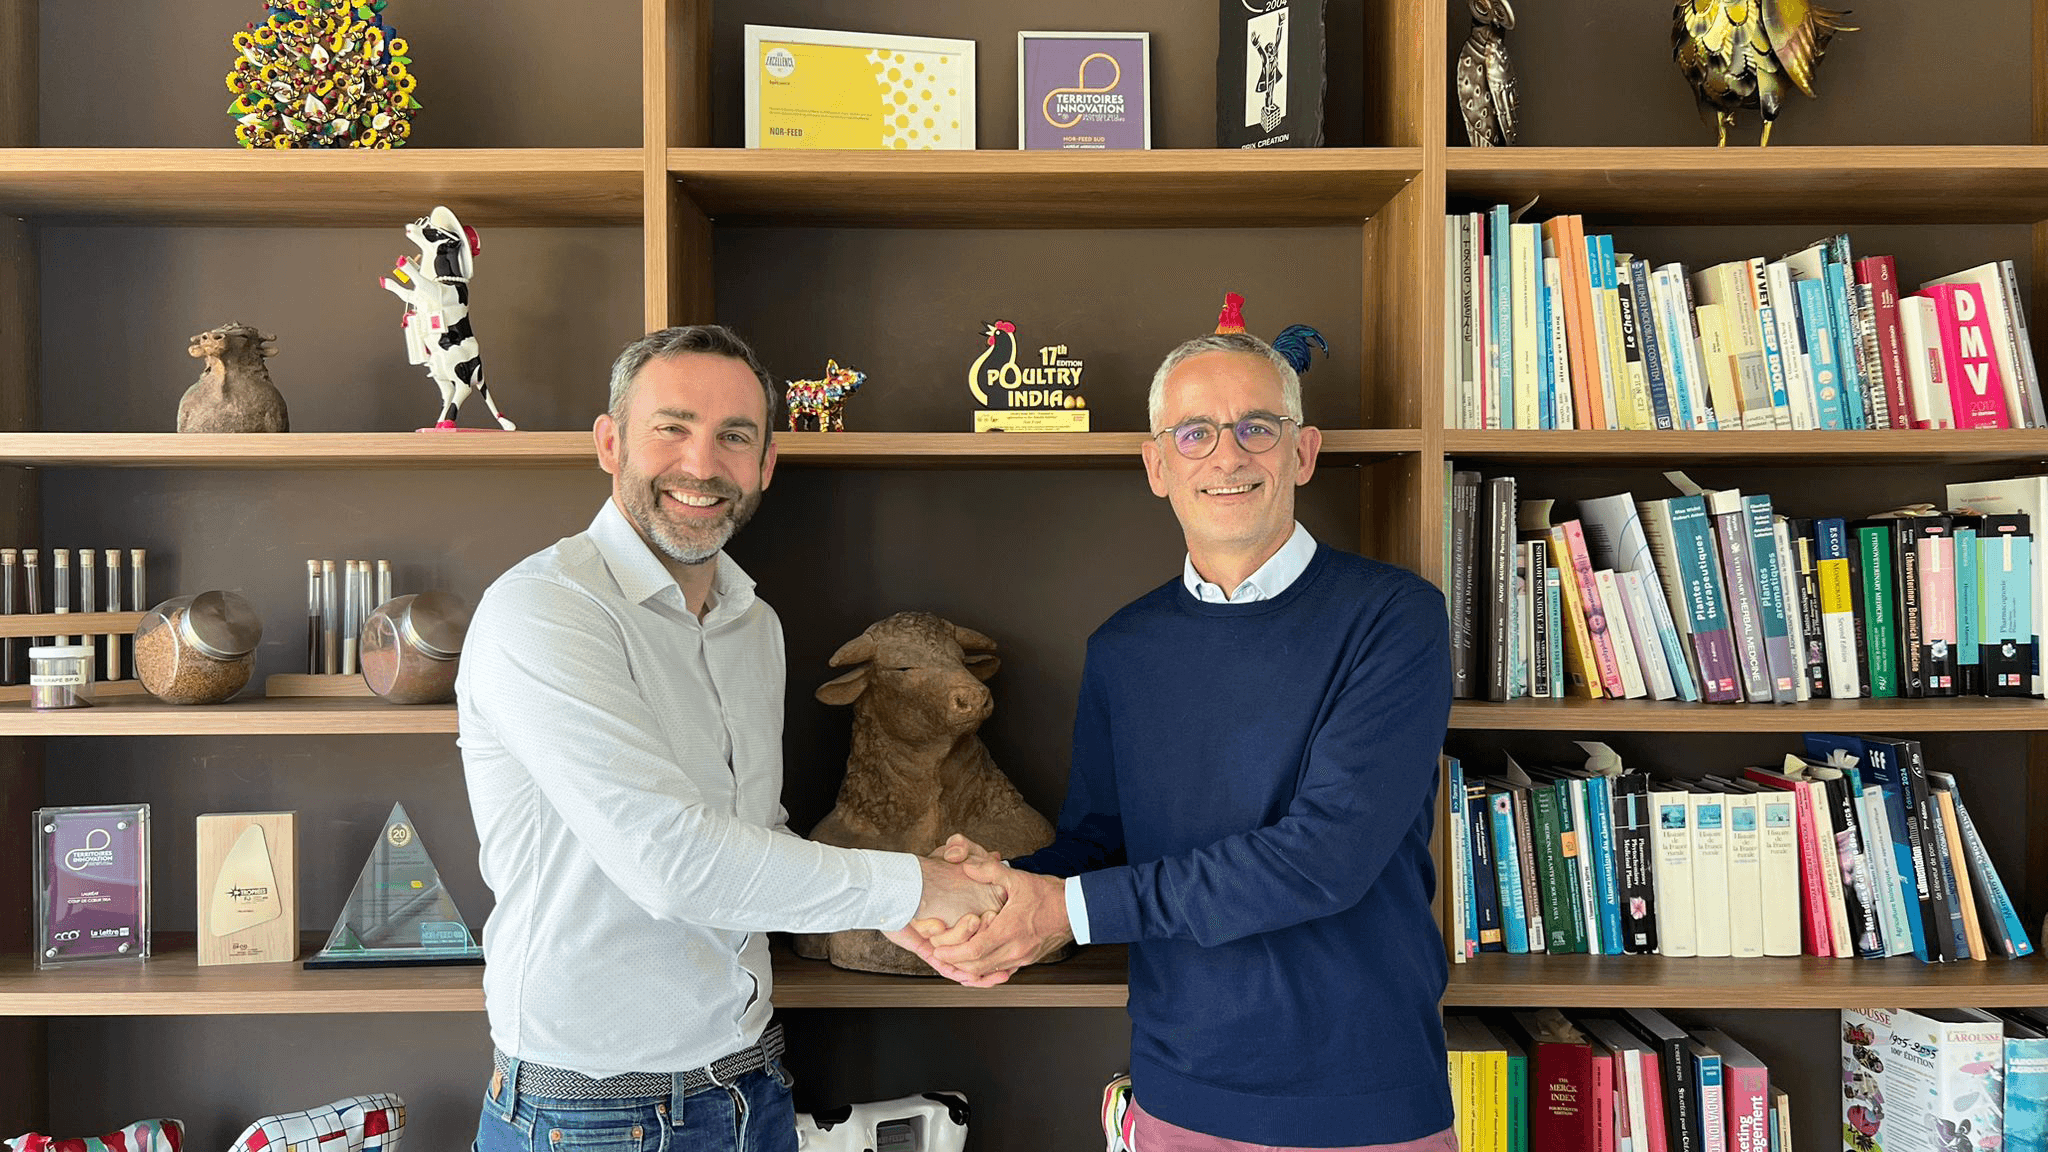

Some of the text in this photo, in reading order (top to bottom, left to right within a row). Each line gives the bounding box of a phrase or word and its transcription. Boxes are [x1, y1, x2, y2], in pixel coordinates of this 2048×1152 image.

[1056, 94, 1124, 104] TERRITOIRES
[1057, 104, 1124, 113] INNOVATION
[770, 127, 802, 137] NOR-FEED
[1258, 134, 1289, 147] CRÉATION
[1754, 262, 1769, 307] TV VET
[1622, 298, 1635, 348] Le Cheval
[1636, 268, 1659, 381] THE RUMEN MICROBIAL ECOSYSTEM
[1761, 310, 1785, 390] SHEEP BOOK
[987, 362, 1082, 389] POULTRY
[1008, 390, 1063, 407] INDIA
[1829, 527, 1840, 558] ESCOP
[1872, 532, 1881, 592] ETHNOVETERINARY
[1696, 535, 1718, 618] thérapeutiques
[1760, 568, 1772, 608] Plantes
[1768, 552, 1784, 619] aromatiques
[1906, 552, 1915, 605] Ethnoveterinary
[1466, 605, 1472, 614] de
[1692, 580, 1704, 621] Plantes
[1800, 587, 1812, 636] Plantes toxiques
[1875, 592, 1883, 624] MEDICINE
[1537, 624, 1543, 634] LE
[1740, 597, 1754, 634] HERBAL
[1747, 636, 1762, 681] MEDICINE
[1870, 750, 1886, 770] iff
[1901, 768, 1914, 809] Édition 2024
[393, 829, 406, 839] 20
[1598, 812, 1608, 838] cheval
[1601, 840, 1610, 850] du
[1849, 834, 1859, 849] des
[1928, 842, 1936, 856] porc
[1602, 852, 1615, 905] Alimentation
[1931, 865, 1941, 890] l'éleveur
[1935, 892, 1942, 901] de
[1860, 892, 1874, 930] Maladies
[1946, 1032, 2000, 1042] LAROUSSE
[1904, 1053, 1934, 1069] ÉDITION
[1549, 1084, 1578, 1092] MERCK
[1551, 1093, 1576, 1102] INDEX
[1710, 1087, 1720, 1140] INNOVATION
